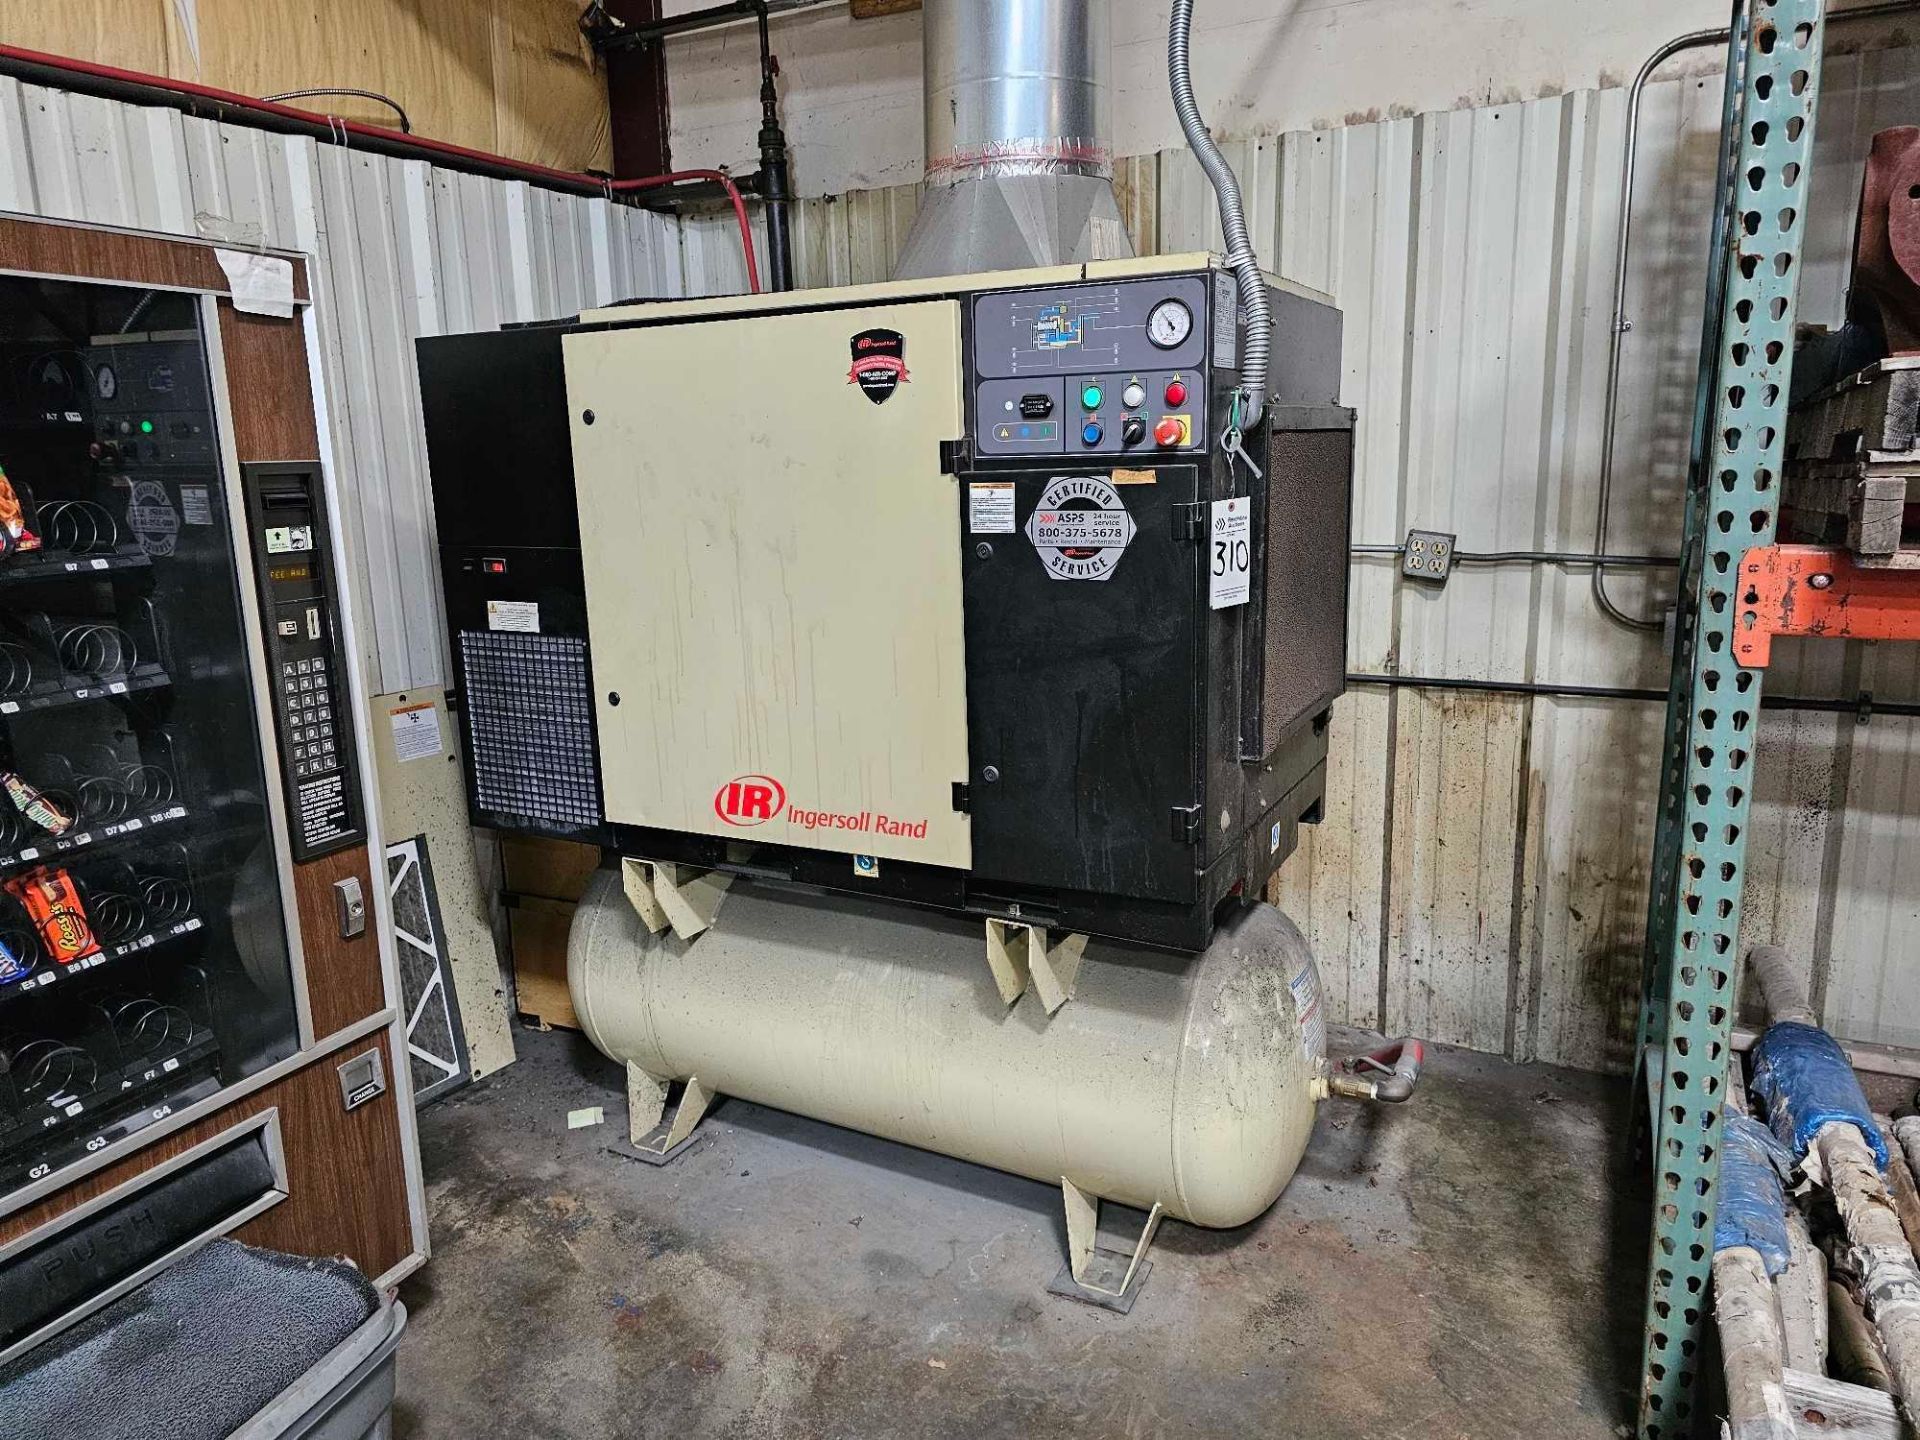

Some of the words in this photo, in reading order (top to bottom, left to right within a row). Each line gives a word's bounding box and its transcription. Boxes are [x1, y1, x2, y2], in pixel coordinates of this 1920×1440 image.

[1047, 482, 1113, 507] CERTIFIED
[1057, 513, 1085, 523] ASPS
[1093, 519, 1121, 527] service
[1038, 527, 1122, 539] 800-375-5678
[1051, 556, 1108, 576] SERVICE
[1213, 540, 1249, 577] 310
[285, 666, 293, 674] A
[311, 745, 318, 753] G
[324, 742, 332, 750] H
[312, 761, 320, 769] K
[326, 758, 333, 766] L
[726, 782, 773, 820] IR
[787, 804, 871, 832] Ingersoll
[874, 814, 929, 840] Rand
[353, 1086, 376, 1102] CHANGE
[29, 1163, 51, 1179] G2
[86, 1136, 107, 1151] G3
[152, 1105, 172, 1120] G4
[40, 1207, 155, 1283] PUSH
